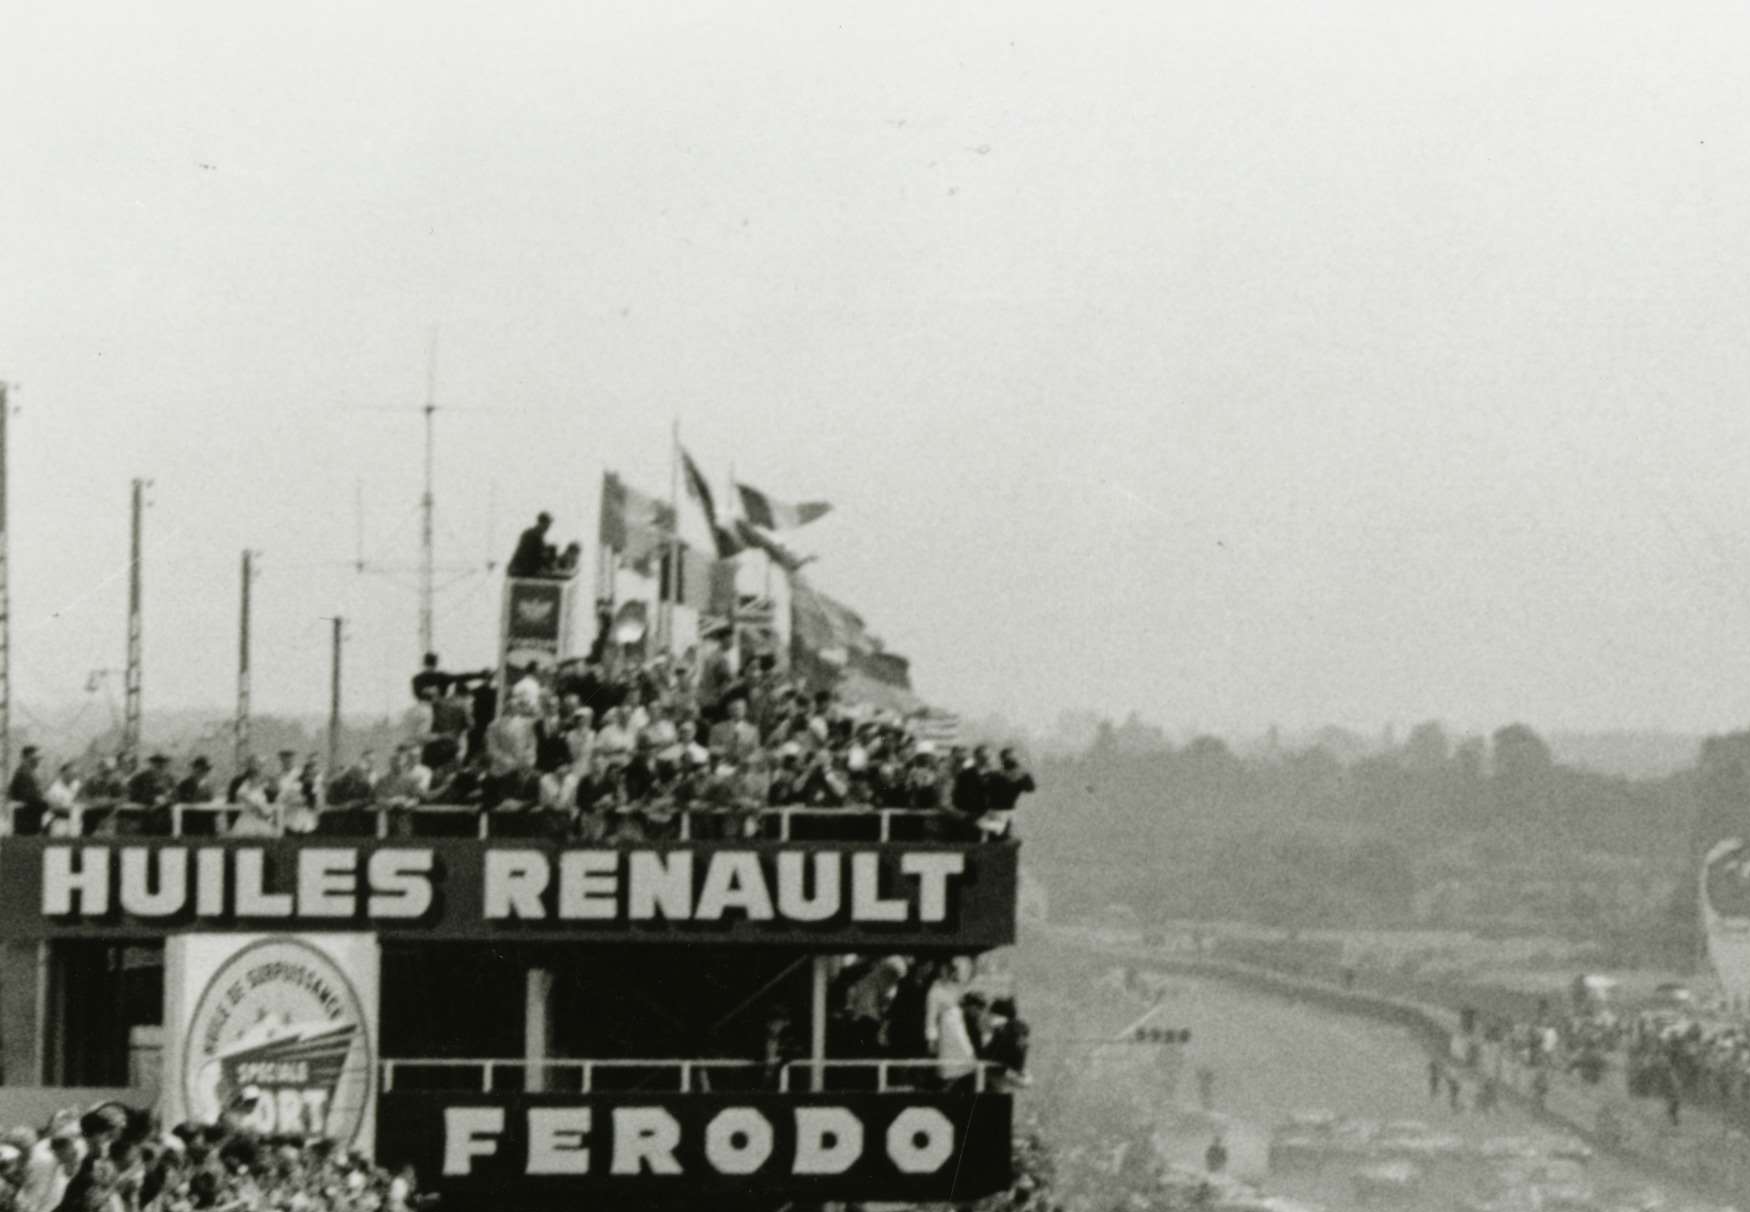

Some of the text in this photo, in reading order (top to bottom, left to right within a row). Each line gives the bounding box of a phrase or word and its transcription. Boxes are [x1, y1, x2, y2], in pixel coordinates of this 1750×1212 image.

[41, 846, 965, 922] HUILES RENAULT
[442, 1106, 956, 1176] FERODO
